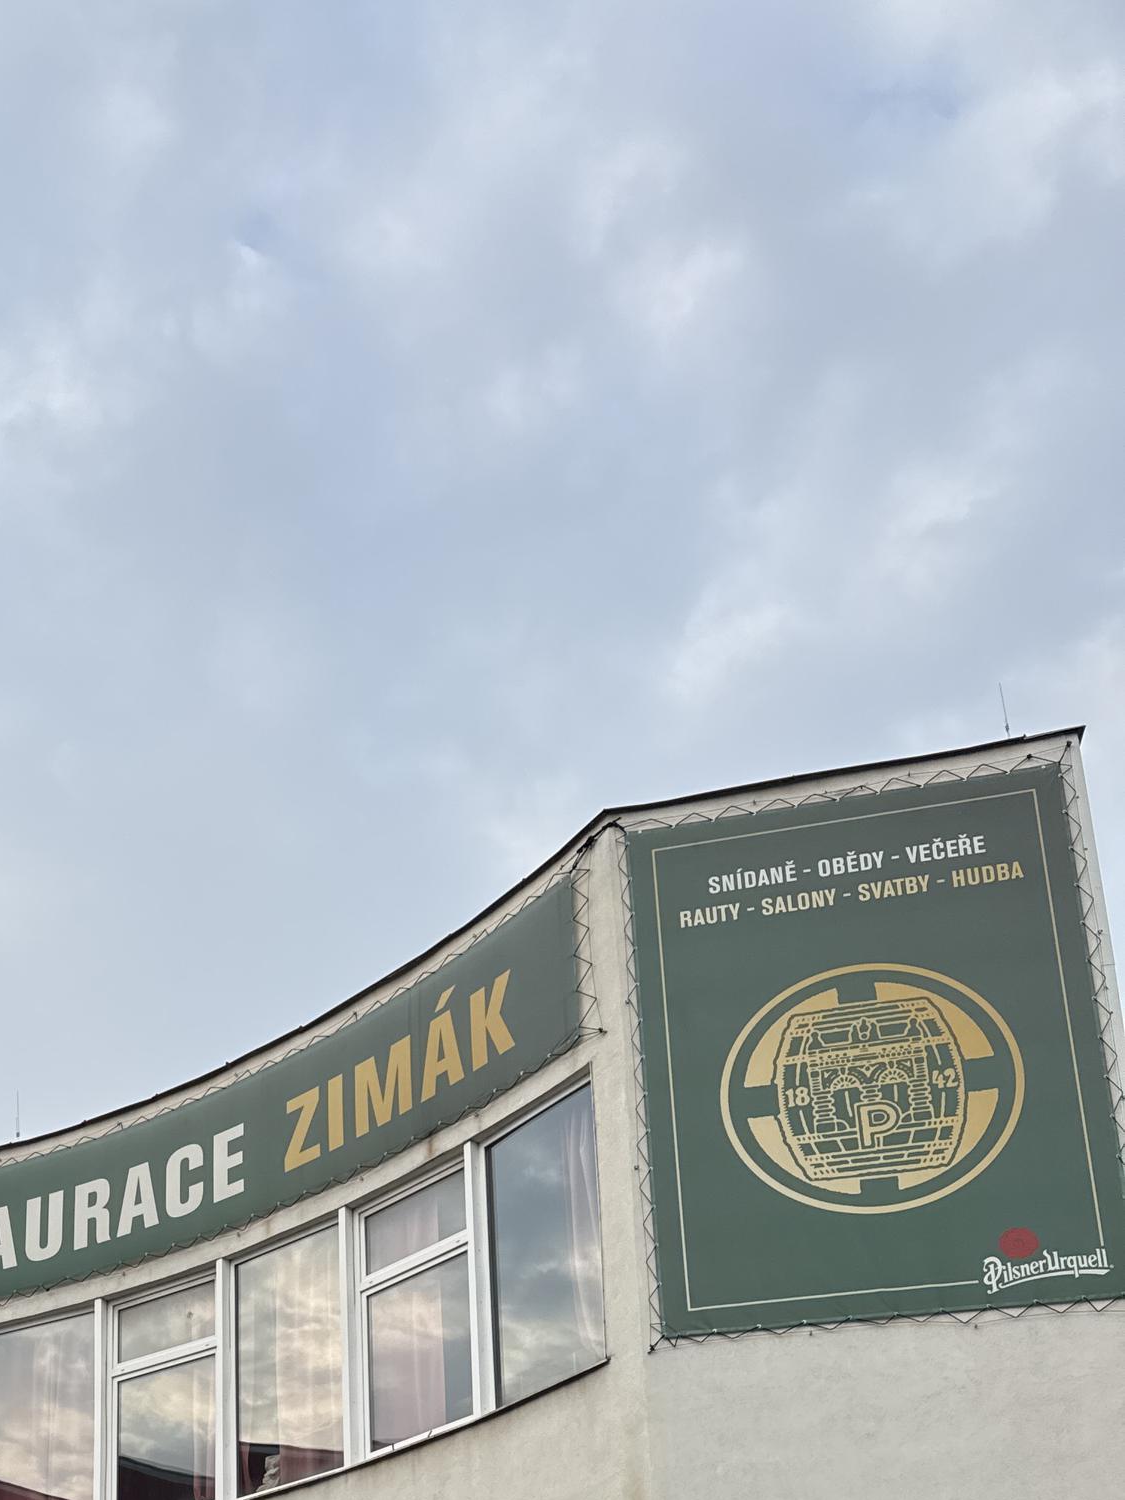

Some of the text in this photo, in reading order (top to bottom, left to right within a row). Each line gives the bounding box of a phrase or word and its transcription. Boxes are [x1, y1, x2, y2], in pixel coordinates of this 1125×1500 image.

[708, 860, 798, 895] SNÍDANĚ
[817, 849, 885, 879] OBĚDY
[905, 833, 987, 865] VEČEŘE
[679, 903, 741, 929] RAUTY
[761, 889, 837, 917] SALONY
[858, 874, 931, 903] SVATBY
[951, 860, 1025, 888] HUDBA
[283, 969, 516, 1174] ZIMÁK
[932, 1068, 958, 1089] 42
[785, 1086, 811, 1107] 18
[856, 1102, 901, 1148] P
[983, 1248, 1109, 1294] Pilsner Urquell
